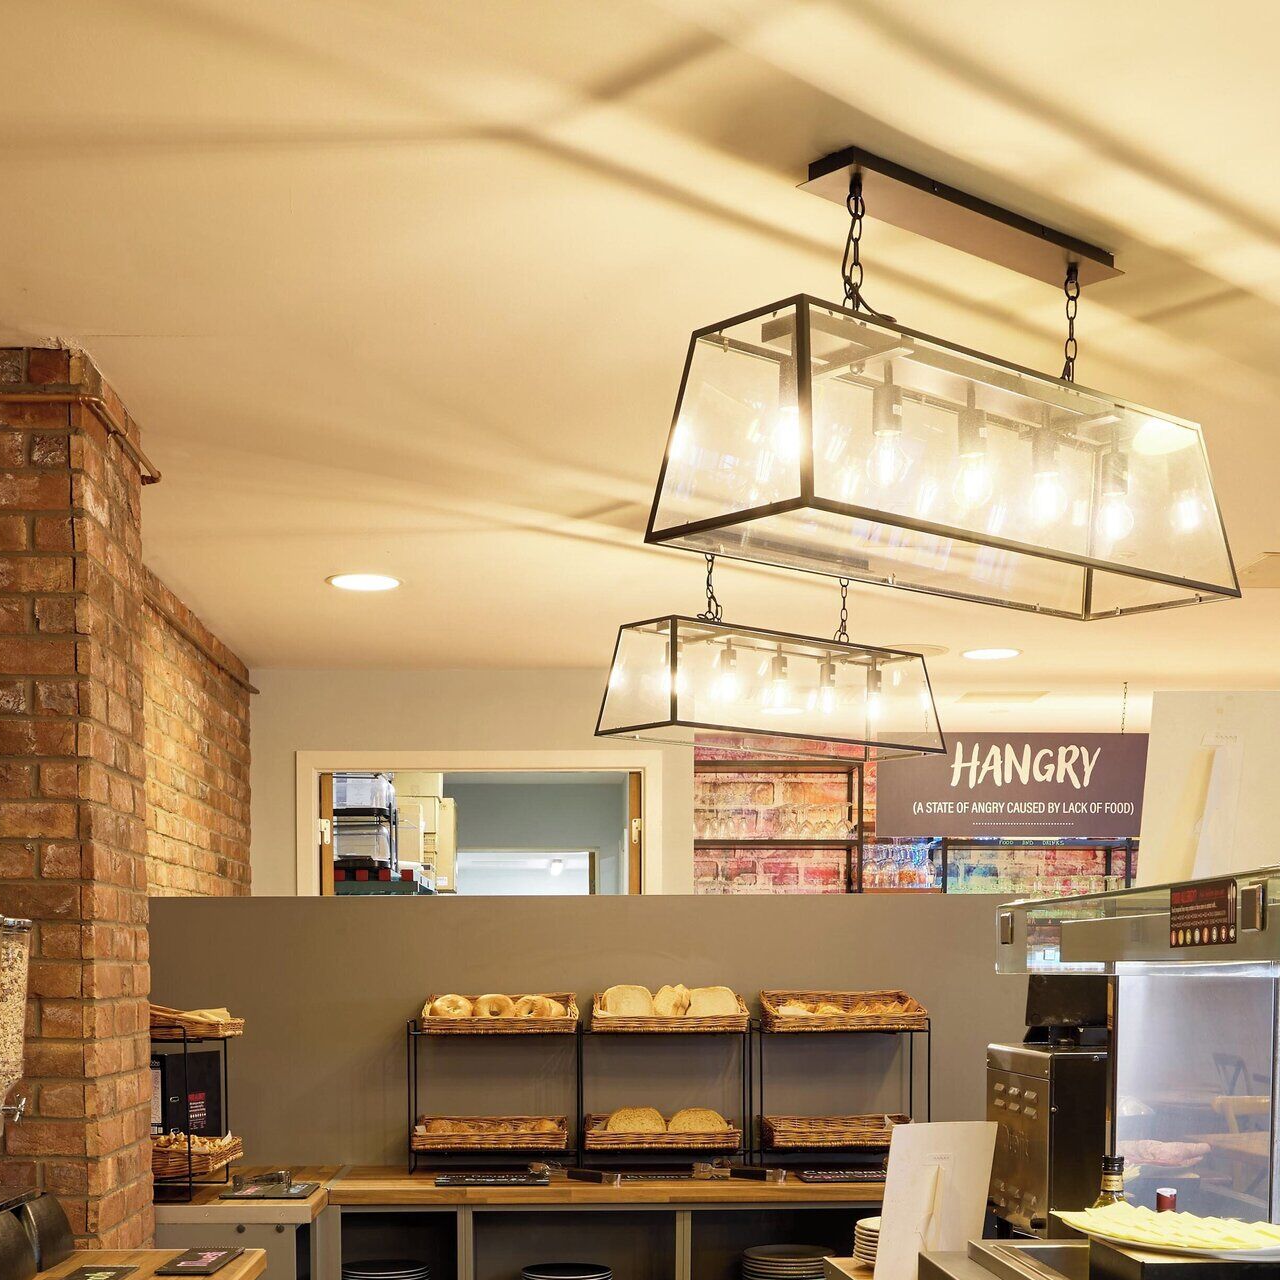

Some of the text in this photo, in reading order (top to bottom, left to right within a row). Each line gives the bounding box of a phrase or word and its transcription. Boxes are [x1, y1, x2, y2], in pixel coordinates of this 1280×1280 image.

[950, 741, 1102, 789] HANGRY
[912, 801, 1135, 815] (A STATE OF ANGRY CAUSED BY LACK OF FOOD)
